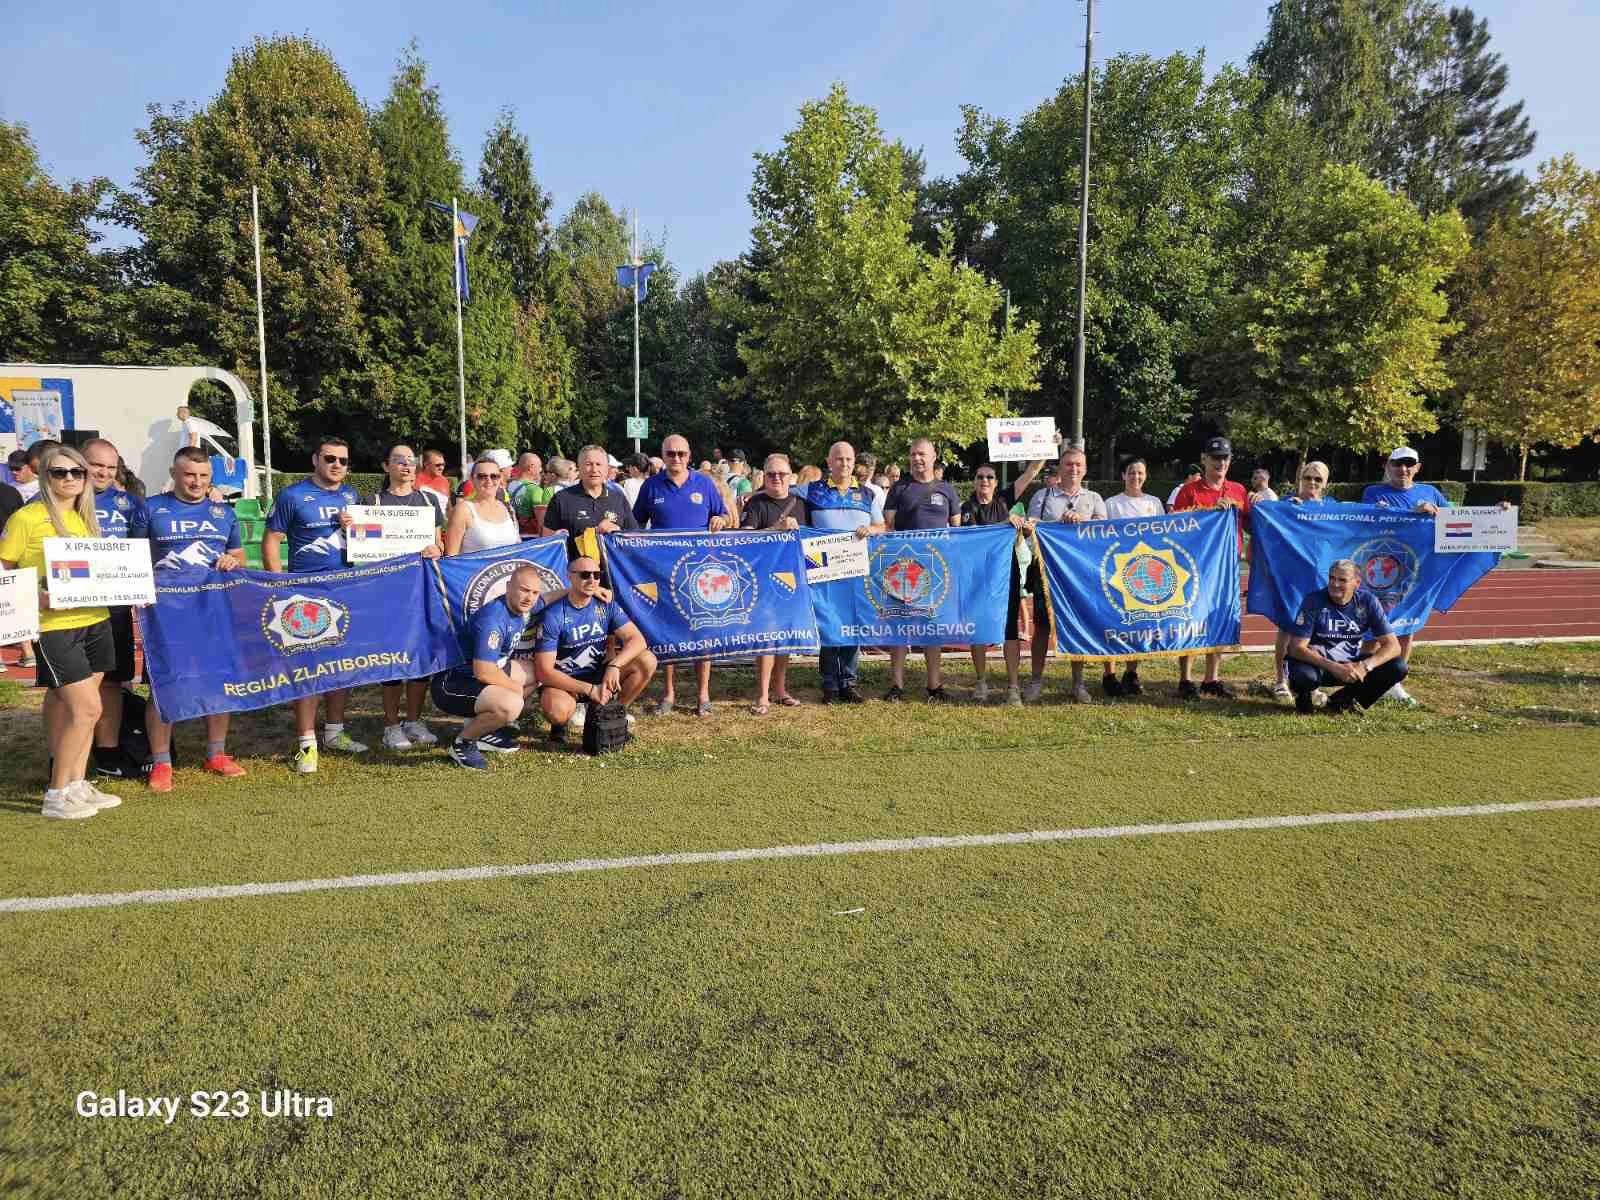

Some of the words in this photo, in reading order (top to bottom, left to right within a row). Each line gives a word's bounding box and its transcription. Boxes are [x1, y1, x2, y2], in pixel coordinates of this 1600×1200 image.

[95, 509, 128, 523] PA
[171, 520, 218, 533] IPA
[1076, 525, 1119, 540] ИПА
[1123, 517, 1201, 537] СРБИЈА
[75, 542, 91, 552] IPA
[613, 536, 694, 548] INTERNATIONAL
[697, 537, 732, 548] POLICE
[572, 621, 605, 641] IPA
[840, 624, 894, 638] REGIJA
[1327, 619, 1361, 633] IPA
[679, 638, 722, 653] BOSNA
[731, 629, 814, 646] HERCEGOVINA
[1104, 627, 1162, 645] Регија
[223, 672, 290, 696] REGIJA
[294, 651, 412, 682] ZLATIBORSKA
